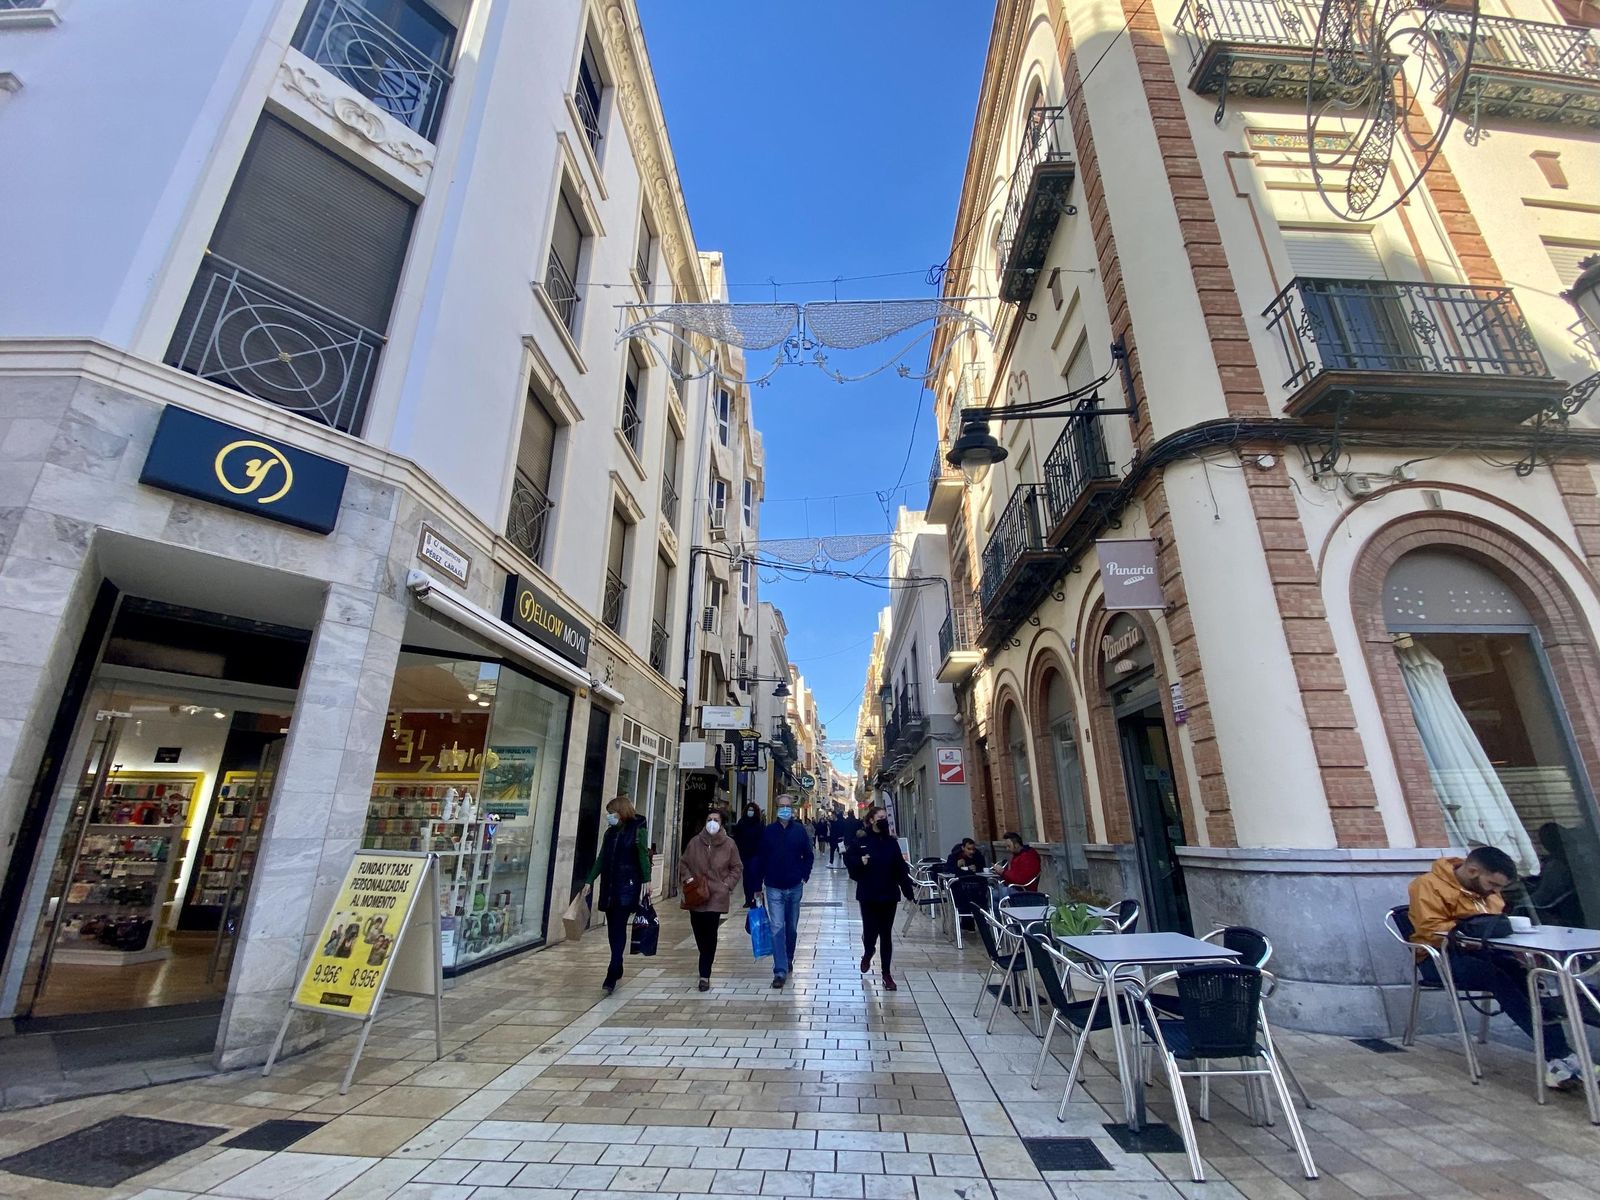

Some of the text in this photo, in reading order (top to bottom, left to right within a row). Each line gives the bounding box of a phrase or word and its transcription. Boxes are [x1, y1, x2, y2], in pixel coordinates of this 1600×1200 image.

[1106, 561, 1154, 576] Panaria
[519, 590, 586, 655] YELLOW MOVIL
[1101, 626, 1139, 663] Panaria
[358, 861, 413, 876] FUNDAS Y TAZAS
[350, 878, 409, 893] PERSONALIZADAS
[350, 894, 397, 909] AL MOMENTO
[313, 964, 380, 988] 9,95€ 8,95€
